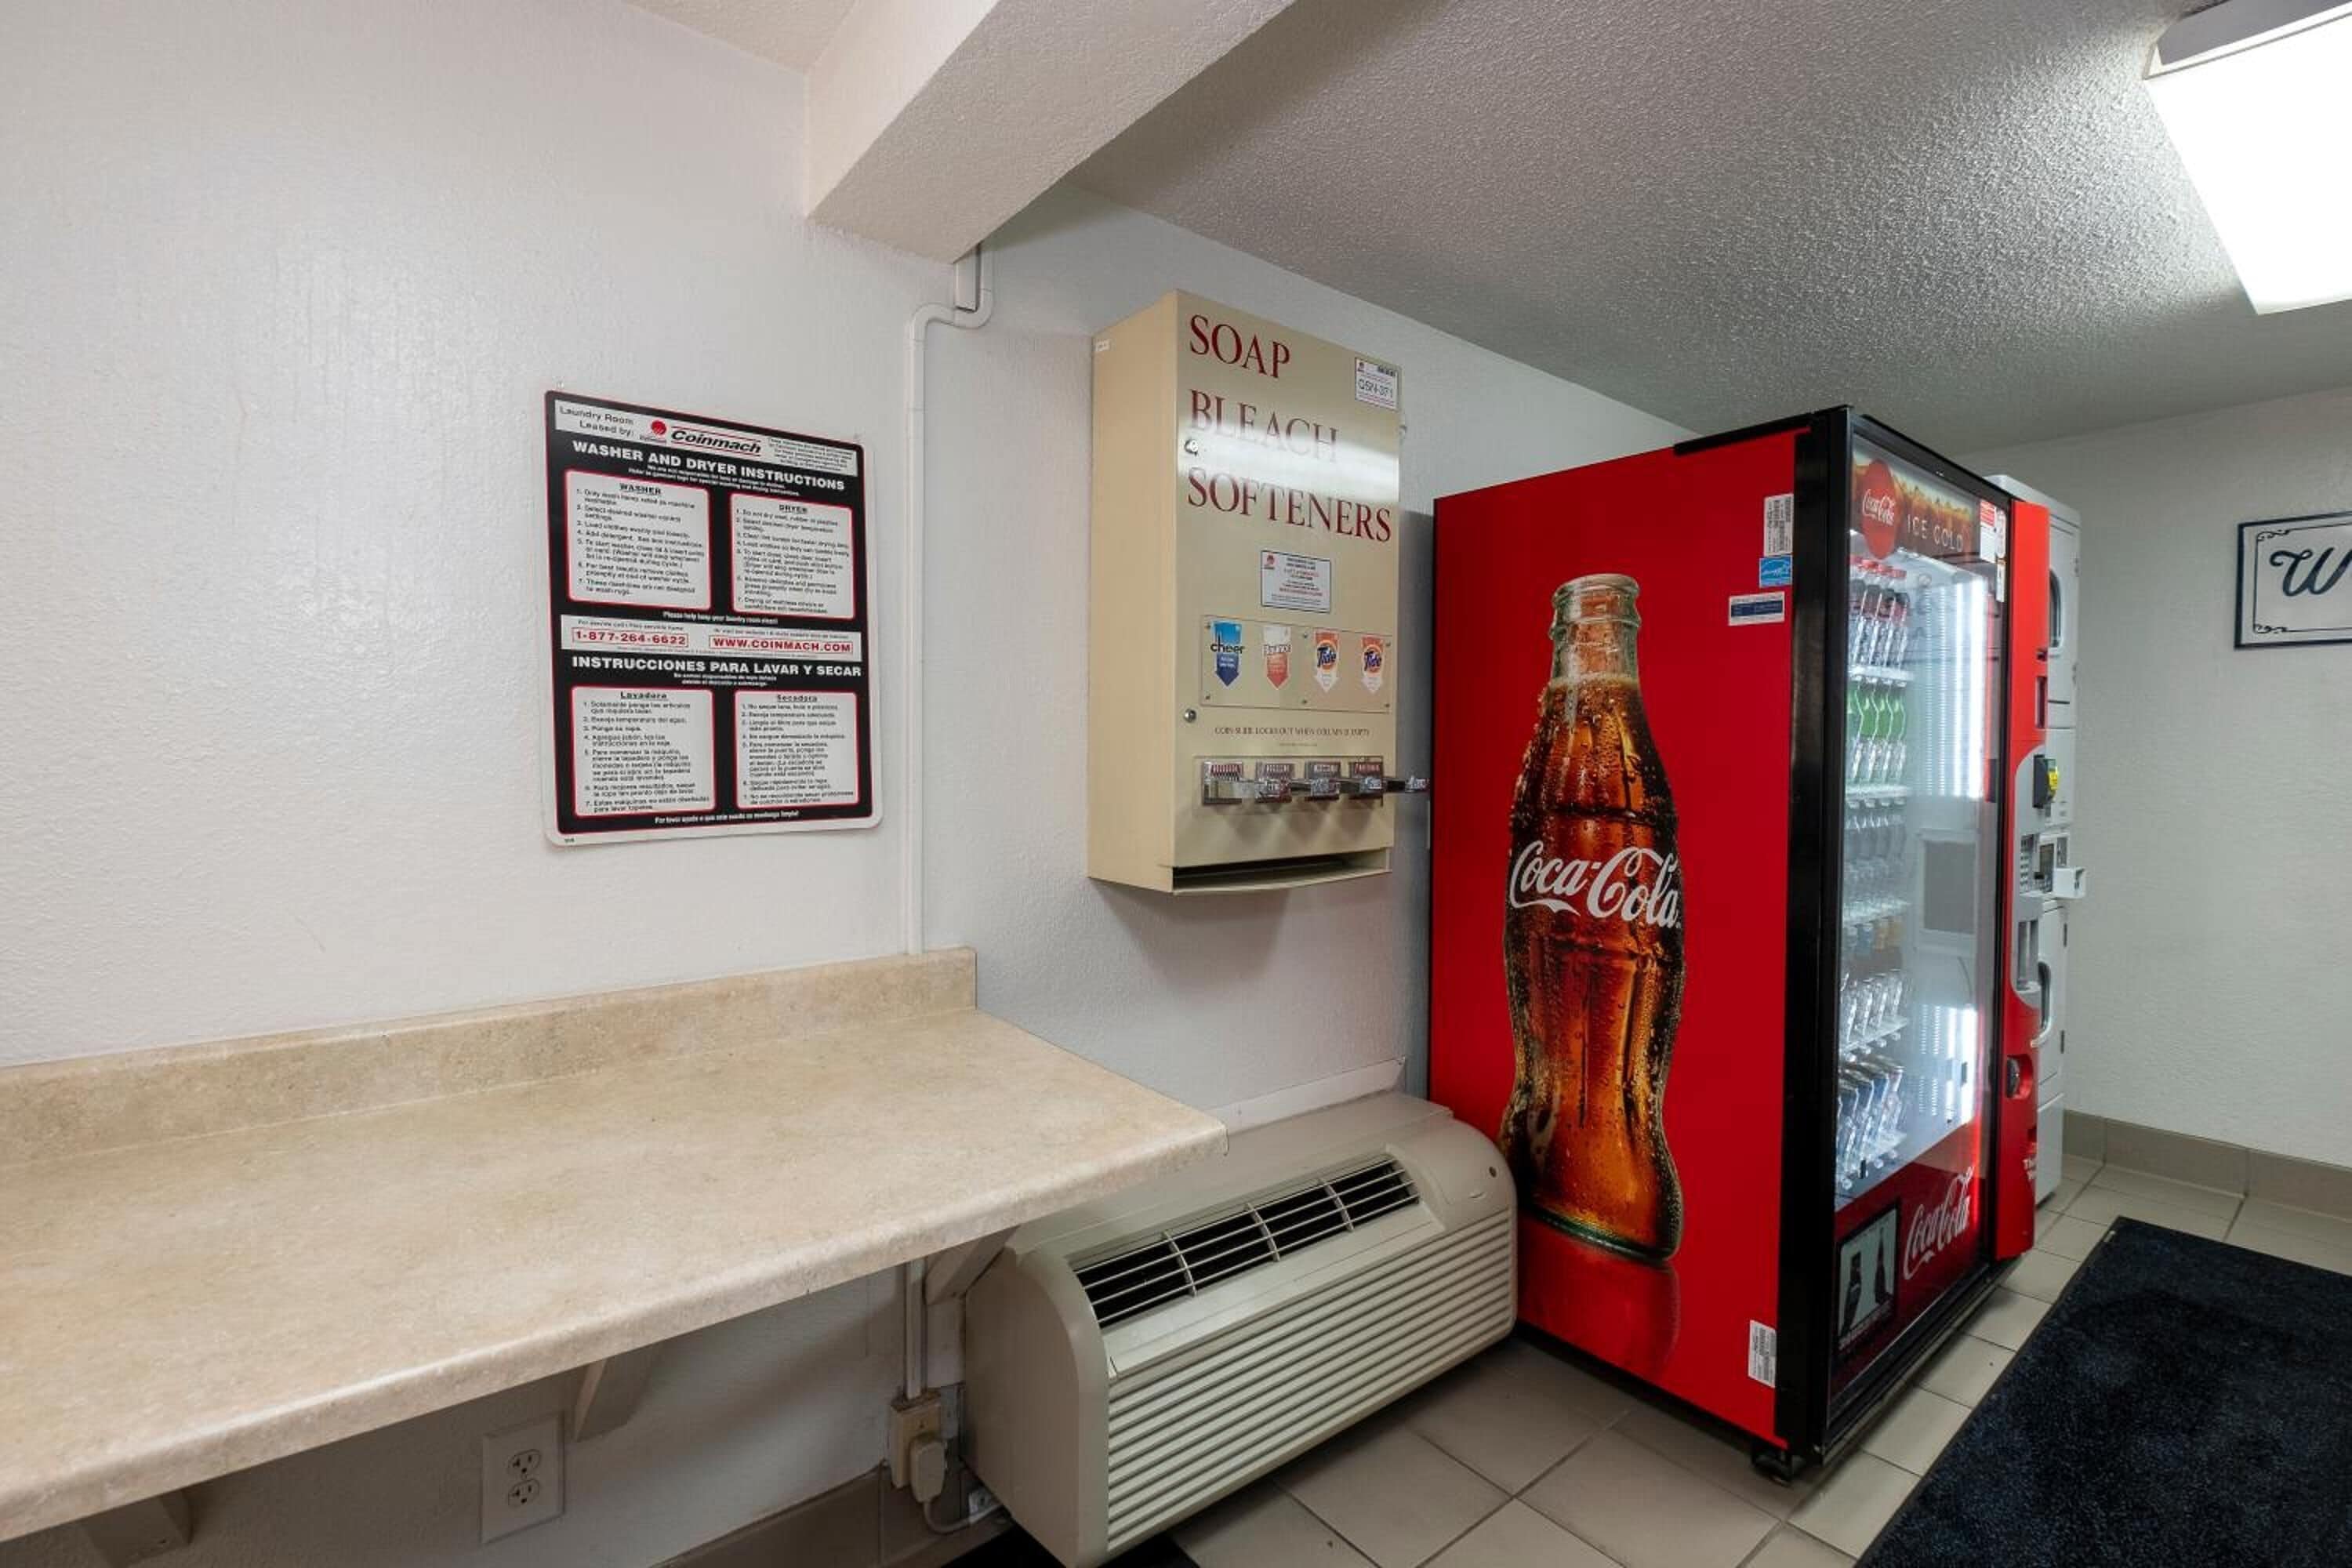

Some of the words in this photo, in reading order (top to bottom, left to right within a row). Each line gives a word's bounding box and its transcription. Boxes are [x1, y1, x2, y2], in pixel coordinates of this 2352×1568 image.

[1190, 314, 1290, 378] SOAP
[559, 406, 601, 420] Laundry
[604, 414, 633, 424] Room
[580, 420, 617, 433] Leased
[1189, 388, 1338, 463] BLEACH
[671, 430, 761, 453] Coinmach
[572, 440, 643, 461] WASHER
[648, 452, 681, 466] AND
[686, 458, 737, 475] DRYER
[741, 466, 845, 491] INSTRUCTIONS
[620, 482, 661, 495] WASHER
[779, 504, 808, 514] DRYER
[1188, 466, 1392, 542] SOFTENERS
[1863, 488, 1896, 526] Coca-Cola
[1907, 514, 1928, 539] ICE
[1933, 524, 1964, 553] COLD
[576, 630, 686, 645] 1-877-264-6622
[713, 637, 851, 652] WWW.COINMACH.COM
[1210, 632, 1245, 654] cheer
[1317, 647, 1337, 668] Tide
[1364, 651, 1382, 672] Tide
[572, 656, 706, 672] INSTRUCCIONES
[710, 661, 749, 673] PARA
[754, 663, 799, 675] LAVAR
[802, 664, 811, 675] Y
[817, 666, 862, 677] SECAR
[620, 691, 667, 699] Lavadora
[1510, 840, 1680, 928] Coca-Cola
[1904, 1166, 1974, 1279] Coca-Cola
